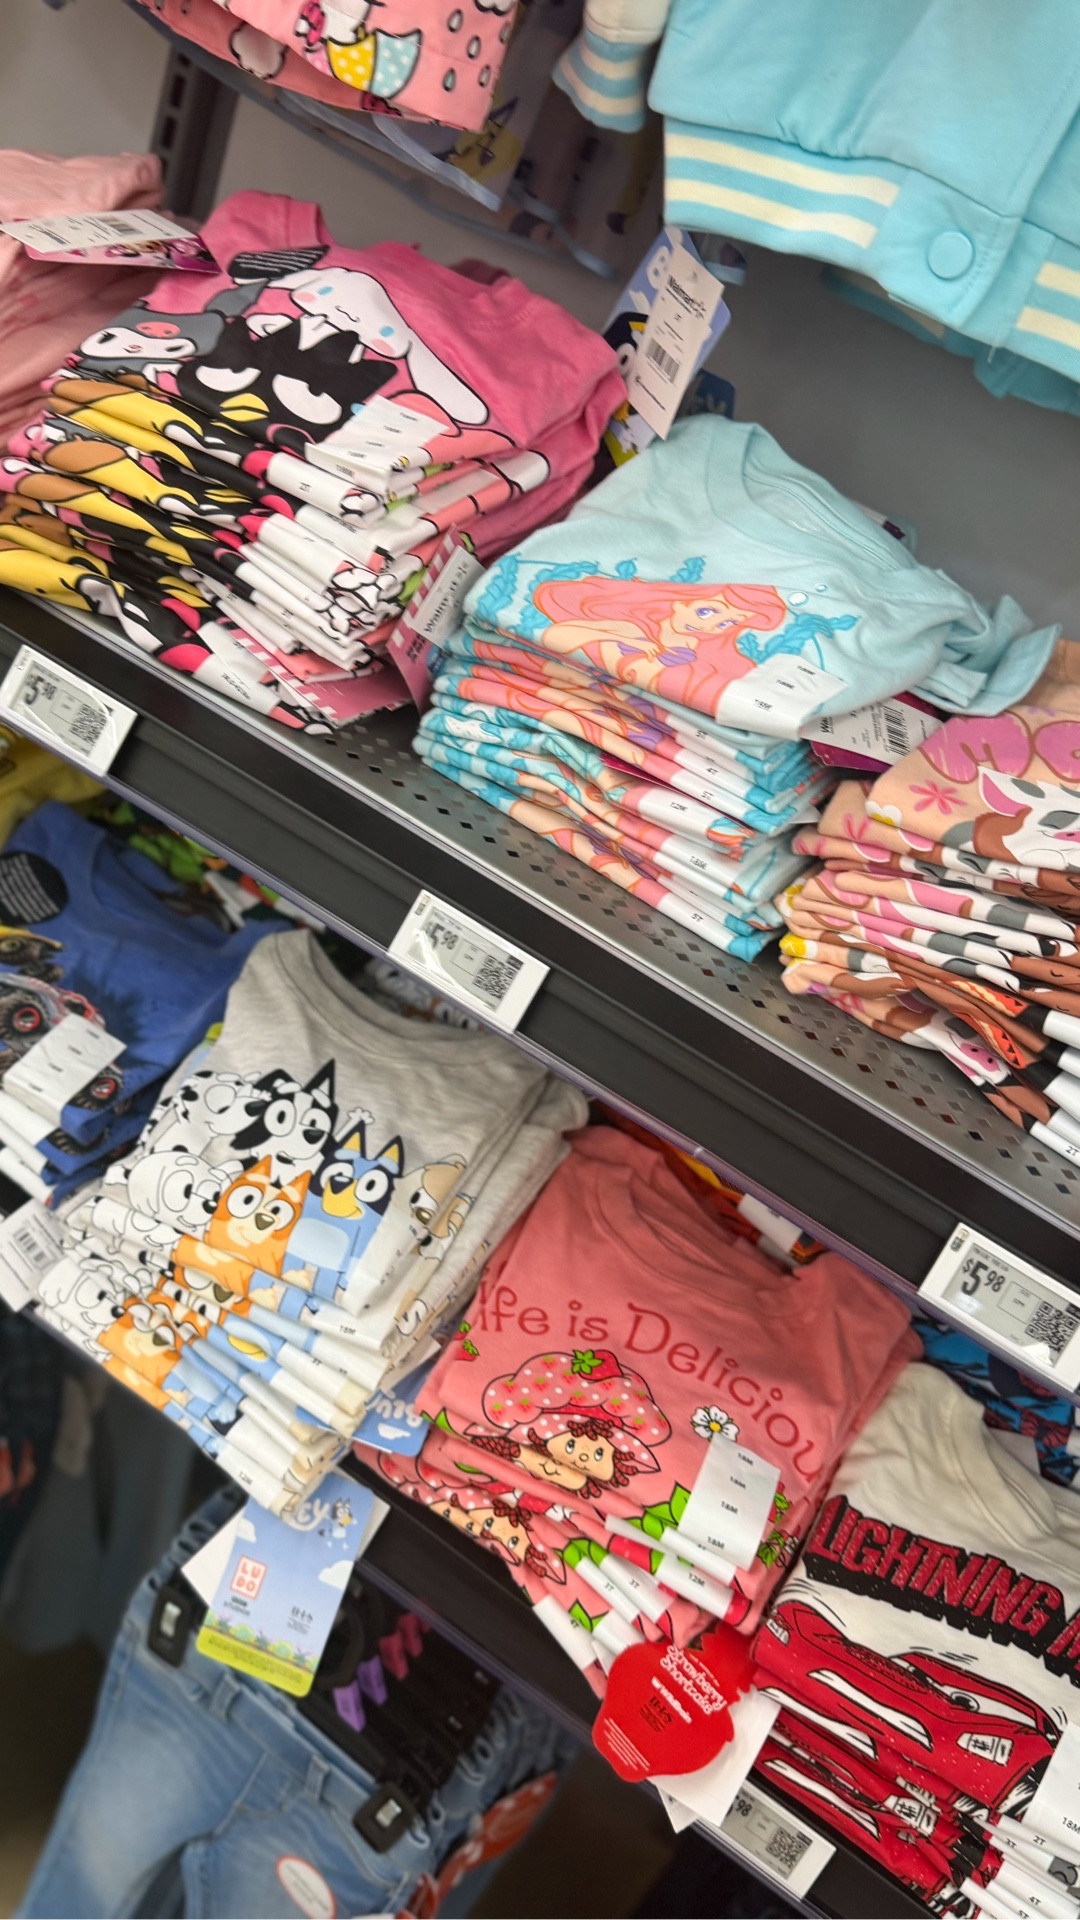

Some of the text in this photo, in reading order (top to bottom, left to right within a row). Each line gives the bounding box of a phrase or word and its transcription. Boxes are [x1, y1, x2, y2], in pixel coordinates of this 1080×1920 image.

[1065, 1145, 1080, 1157] 2T
[568, 1300, 609, 1342] is
[625, 1301, 824, 1484] Deliciou
[707, 1536, 725, 1549] 18M
[802, 1494, 1066, 1645] LIGHTNING
[628, 1578, 640, 1589] 3T
[688, 1573, 705, 1587] 12M
[667, 1644, 728, 1711] Strawberry
[660, 1654, 713, 1716] Shortcake
[1033, 1835, 1046, 1846] 2T
[1029, 1896, 1042, 1906] 4T
